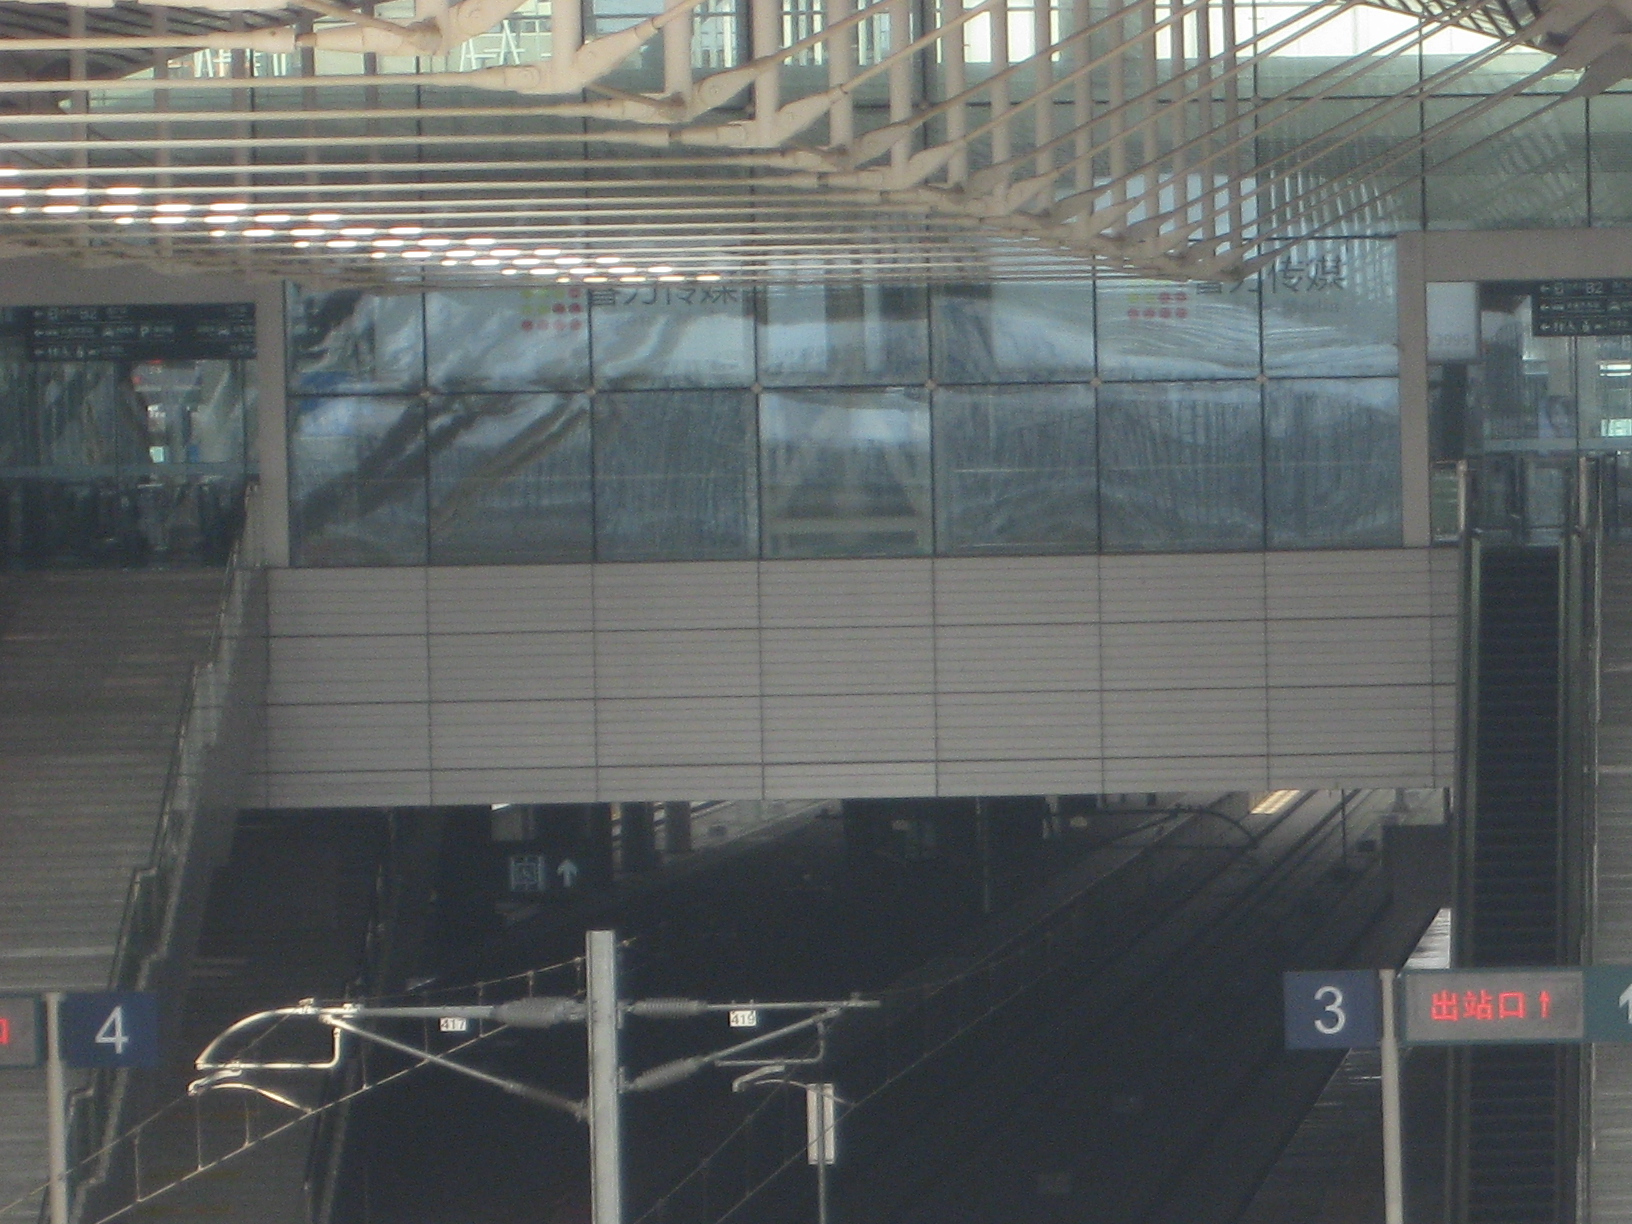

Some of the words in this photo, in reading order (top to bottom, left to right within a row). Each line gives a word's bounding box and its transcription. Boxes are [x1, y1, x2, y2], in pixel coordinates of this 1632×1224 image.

[731, 1013, 756, 1025] 419
[1314, 986, 1346, 1034] 3
[1430, 990, 1527, 1021] 出站口
[95, 1005, 129, 1054] 4
[440, 1018, 466, 1030] 417
